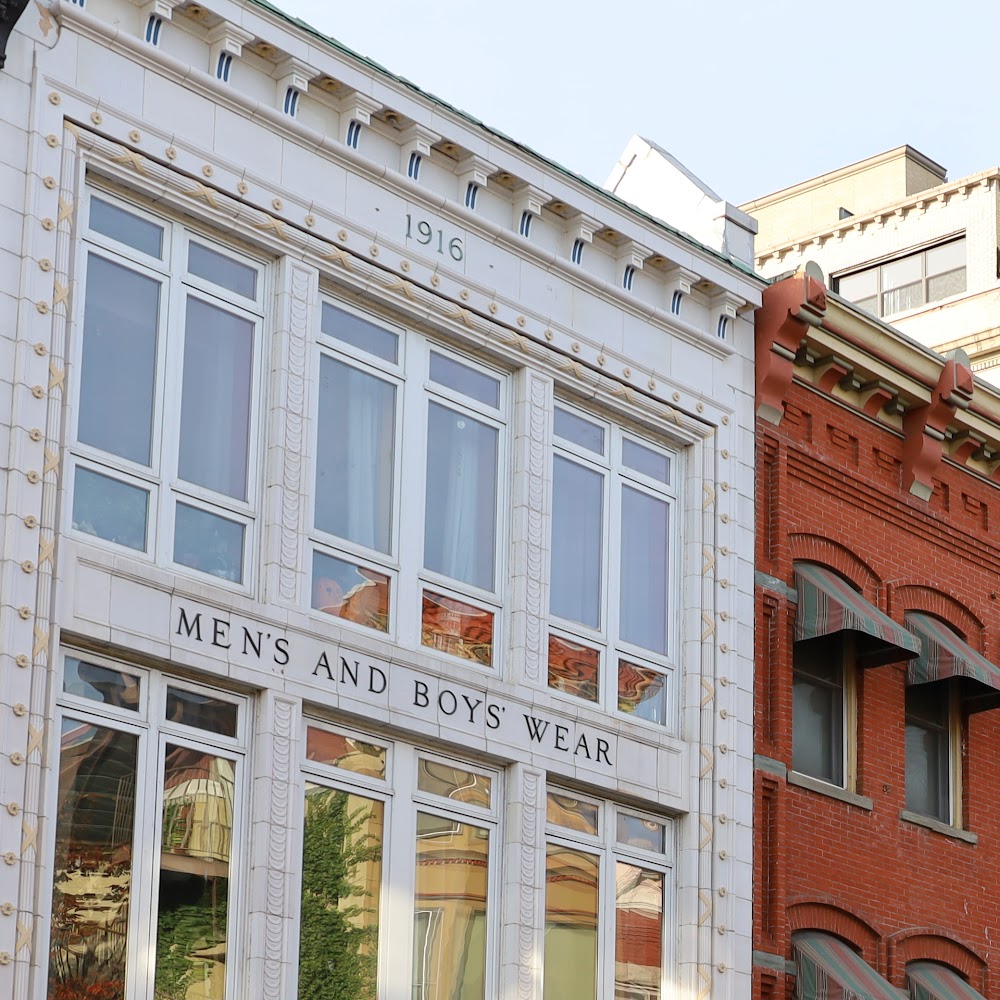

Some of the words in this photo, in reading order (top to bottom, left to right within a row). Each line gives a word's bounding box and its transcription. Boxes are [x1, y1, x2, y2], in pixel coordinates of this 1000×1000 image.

[406, 214, 463, 261] 1916
[175, 607, 290, 665] MEN'S
[312, 651, 387, 694] AND
[413, 680, 506, 728] BOYS'
[523, 713, 613, 766] WEAR
